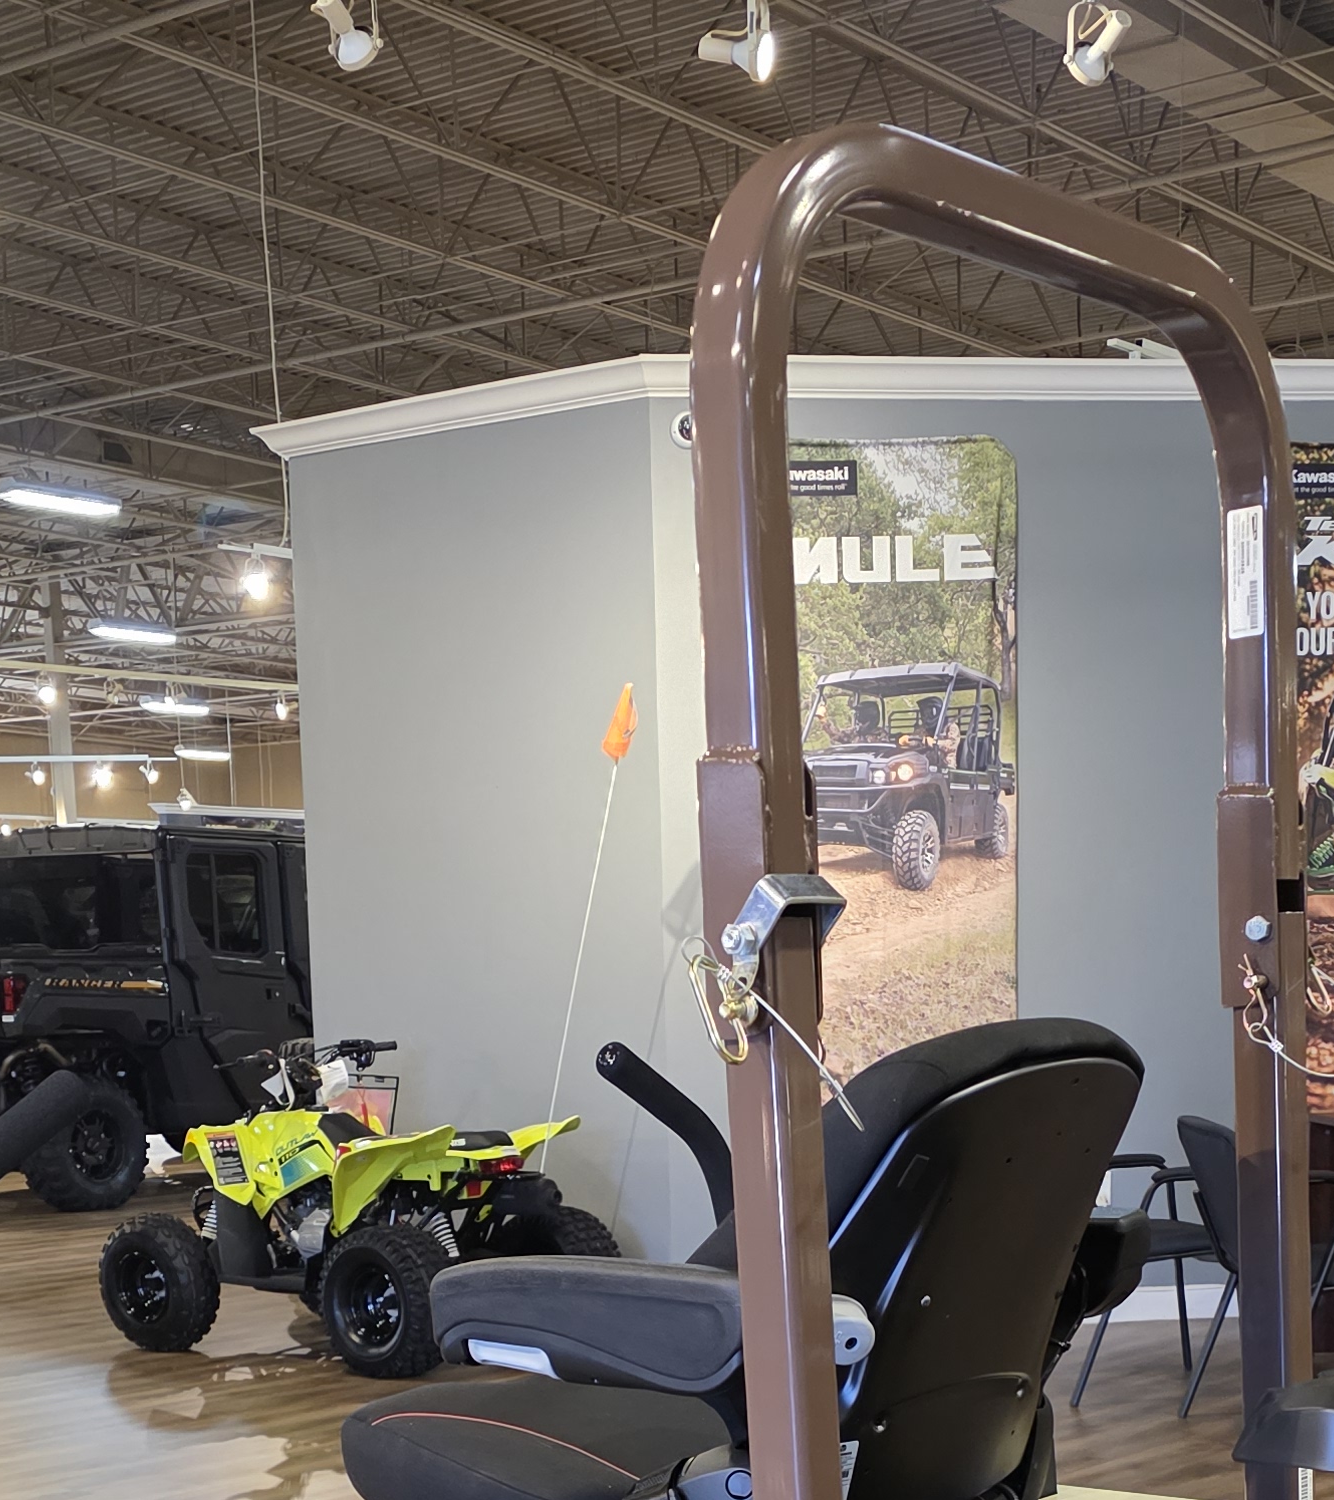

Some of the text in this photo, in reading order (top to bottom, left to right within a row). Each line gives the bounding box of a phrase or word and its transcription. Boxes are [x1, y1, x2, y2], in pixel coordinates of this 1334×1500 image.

[789, 466, 849, 481] wasaki
[800, 484, 816, 492] good
[1311, 486, 1327, 494] good
[792, 533, 1000, 585] MULE
